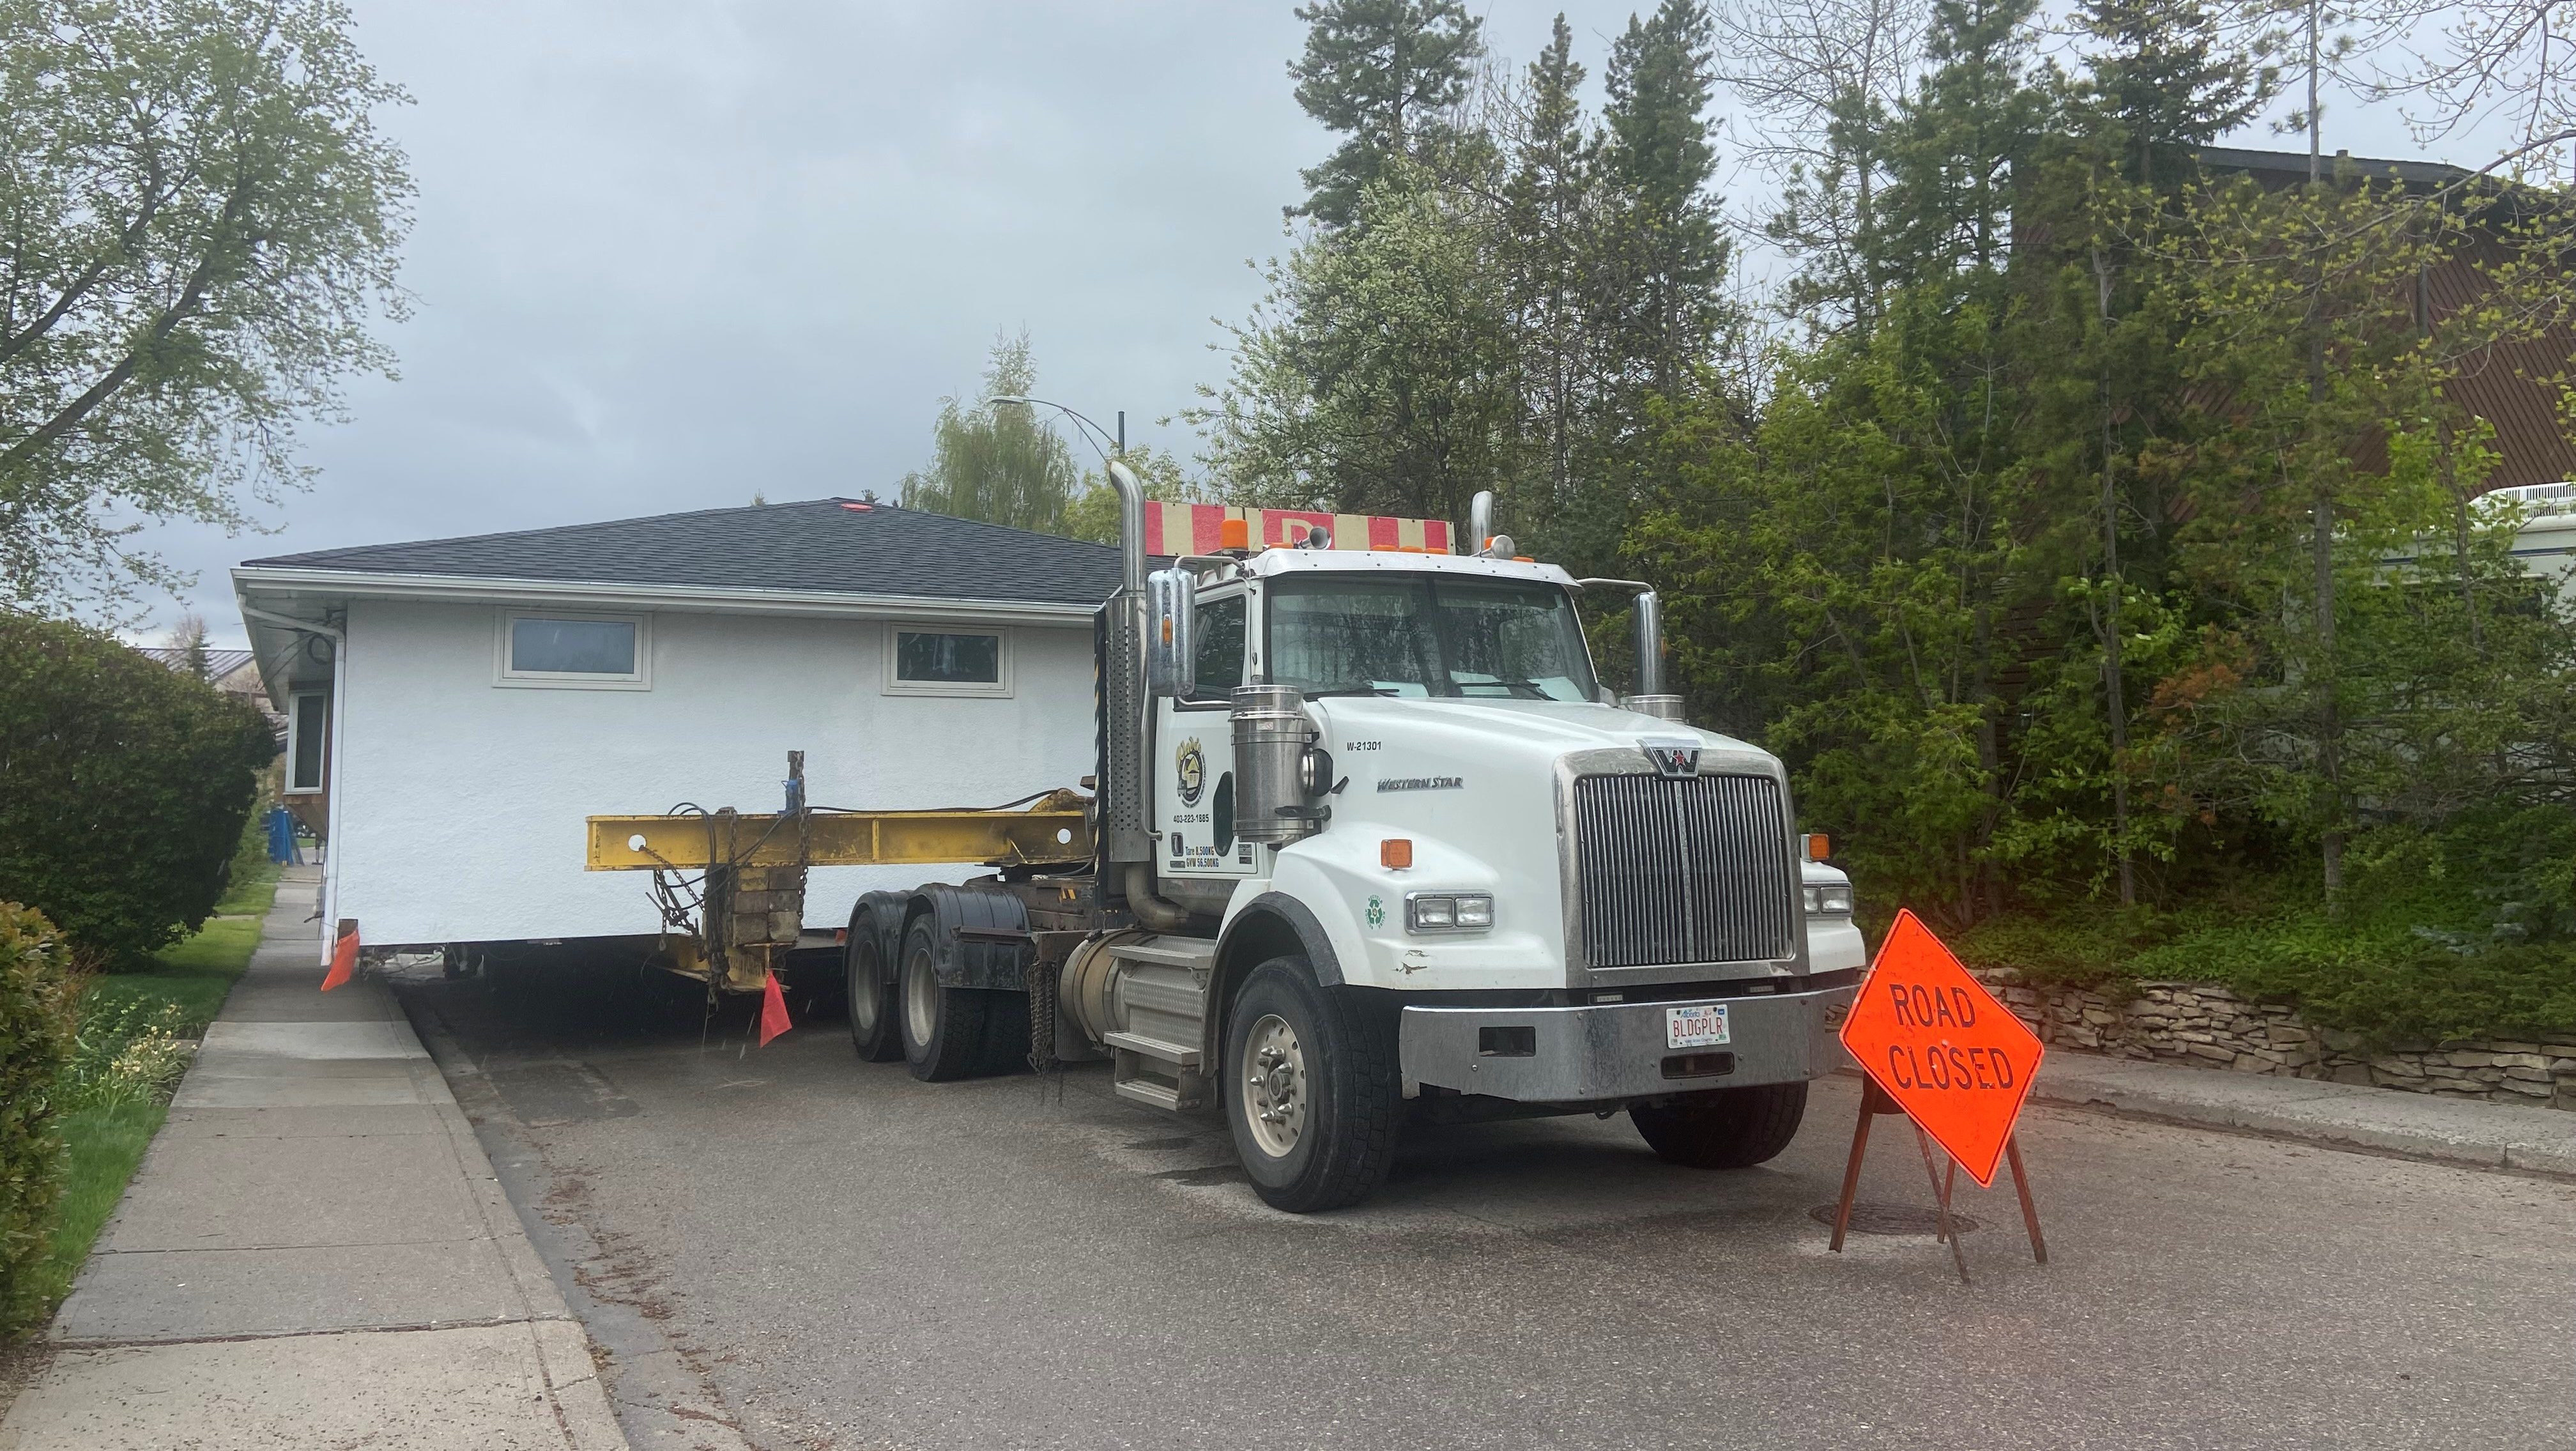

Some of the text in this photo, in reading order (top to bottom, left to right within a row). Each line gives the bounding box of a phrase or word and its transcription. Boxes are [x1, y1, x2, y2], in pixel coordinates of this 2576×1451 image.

[1347, 741, 1381, 751] W-21301
[1377, 776, 1464, 793] WESTERN STAR
[1185, 845, 1215, 857] Tare 8,500KG
[1186, 857, 1196, 868] GVW
[1197, 857, 1220, 868] 56,500KG
[1889, 983, 1977, 1028] ROAD
[1673, 1017, 1722, 1037] BLDGPLR
[1889, 1044, 2014, 1091] CLOSED
